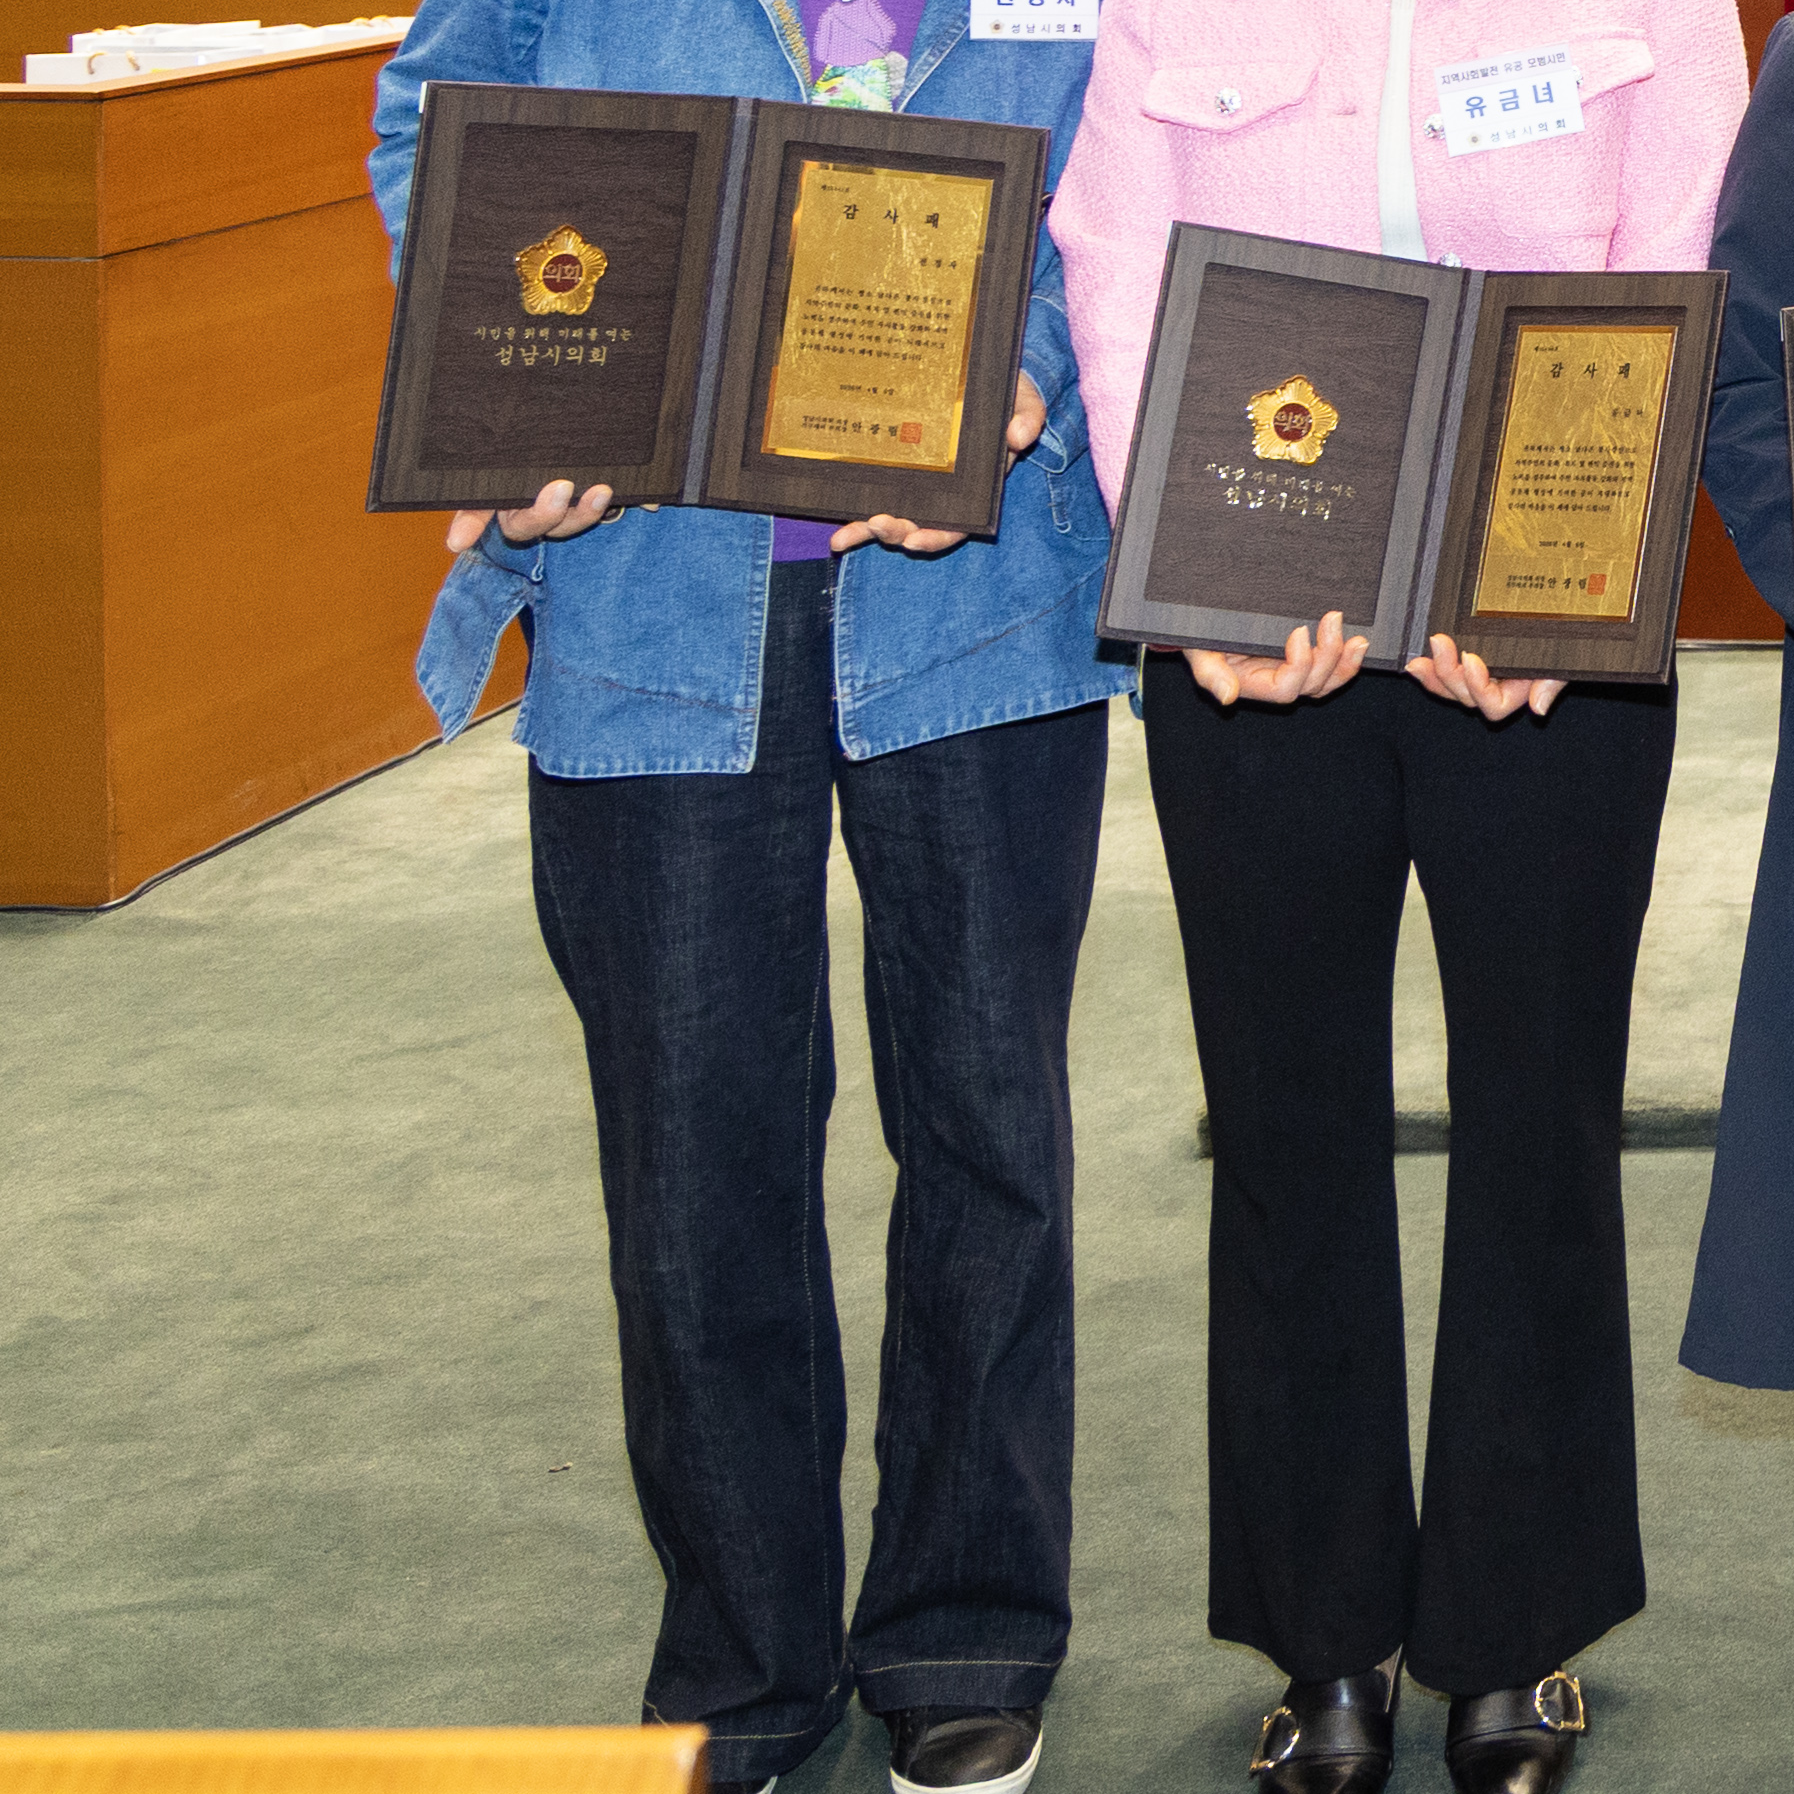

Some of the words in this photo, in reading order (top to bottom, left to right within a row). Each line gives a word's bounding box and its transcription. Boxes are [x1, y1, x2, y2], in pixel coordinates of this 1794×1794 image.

[1441, 65, 1499, 86] 지역사회발전
[1503, 60, 1523, 74] 유공
[1527, 51, 1566, 69] 모범시민
[543, 263, 582, 283] 의회
[495, 344, 609, 367] 성남시의회
